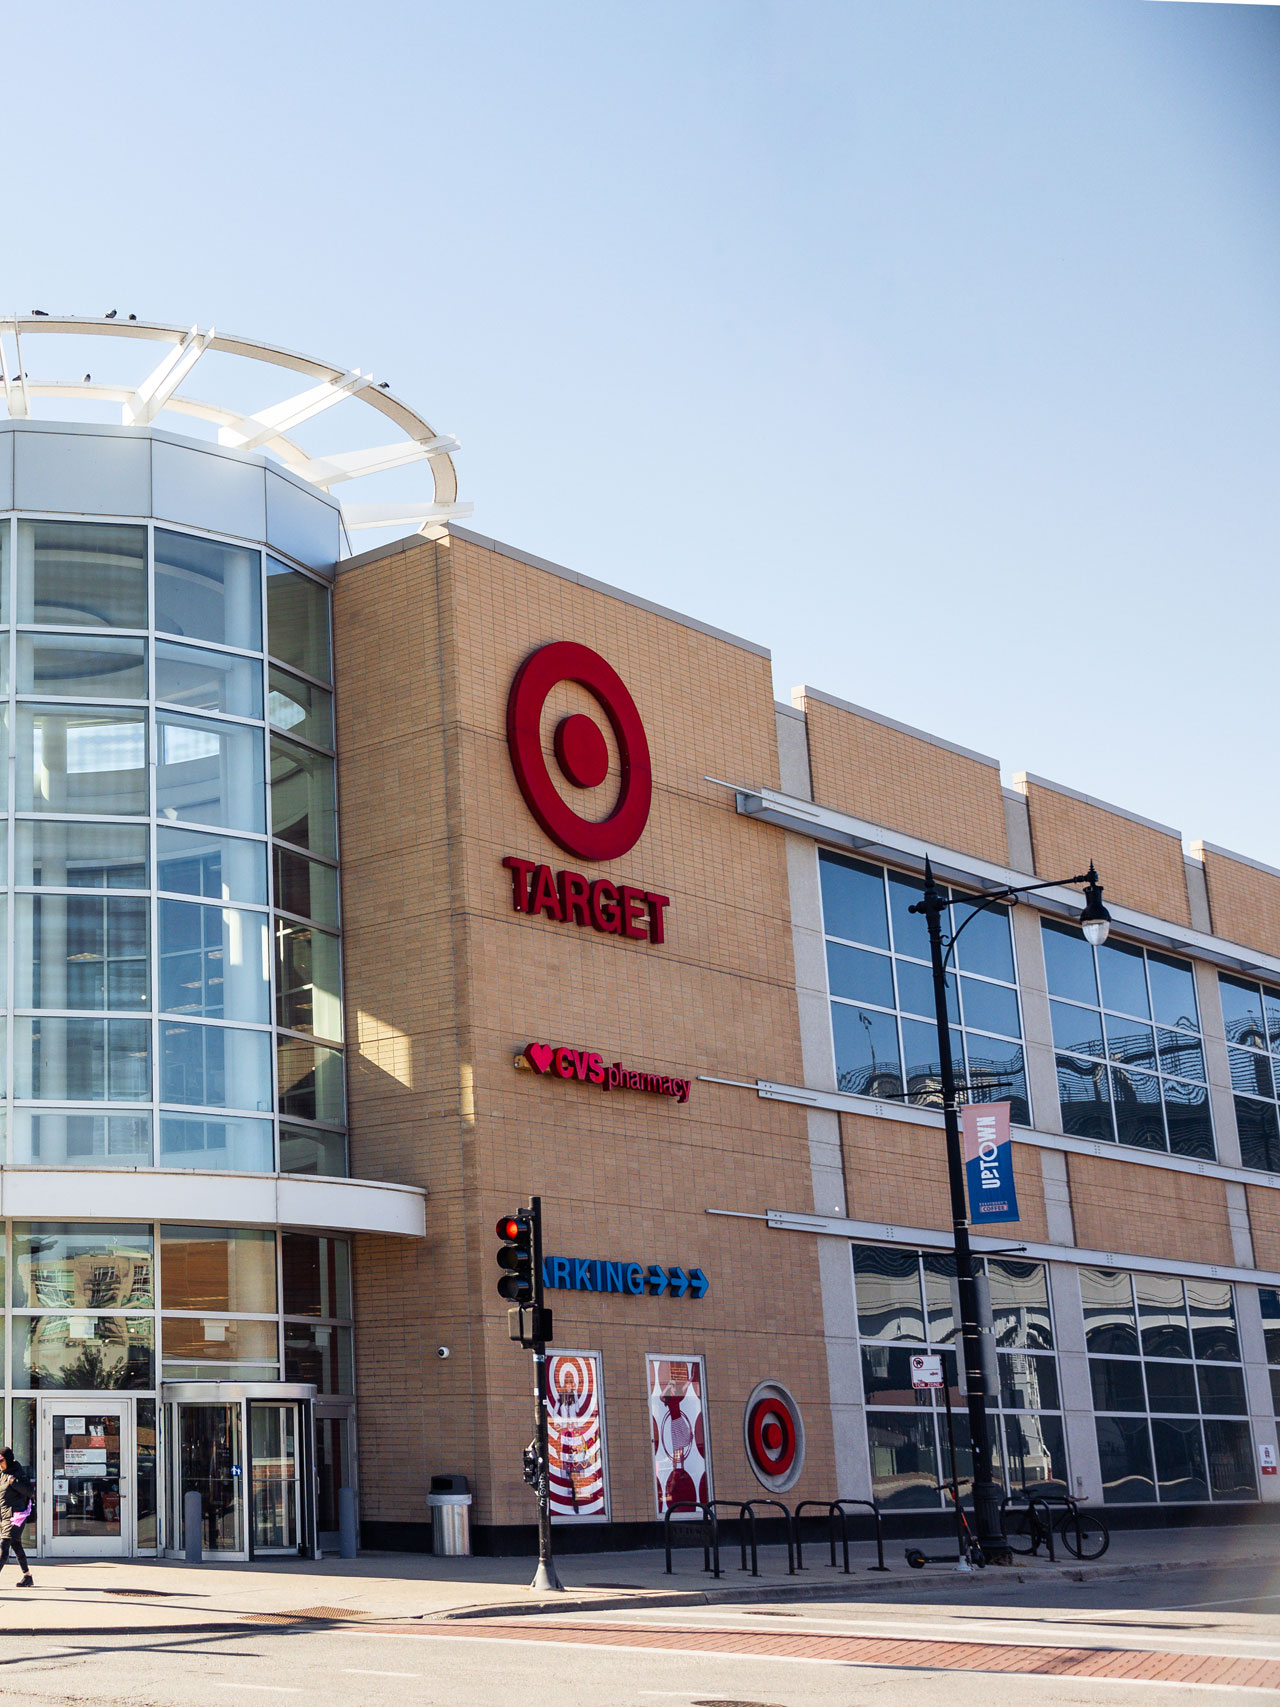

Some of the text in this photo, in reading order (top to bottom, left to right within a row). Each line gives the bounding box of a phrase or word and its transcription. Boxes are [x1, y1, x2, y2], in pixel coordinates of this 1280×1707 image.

[502, 856, 670, 944] TARGET
[550, 1046, 692, 1104] CVS pharmacy
[976, 1116, 1001, 1189] UPTOWN
[542, 1256, 645, 1295] ARKING
